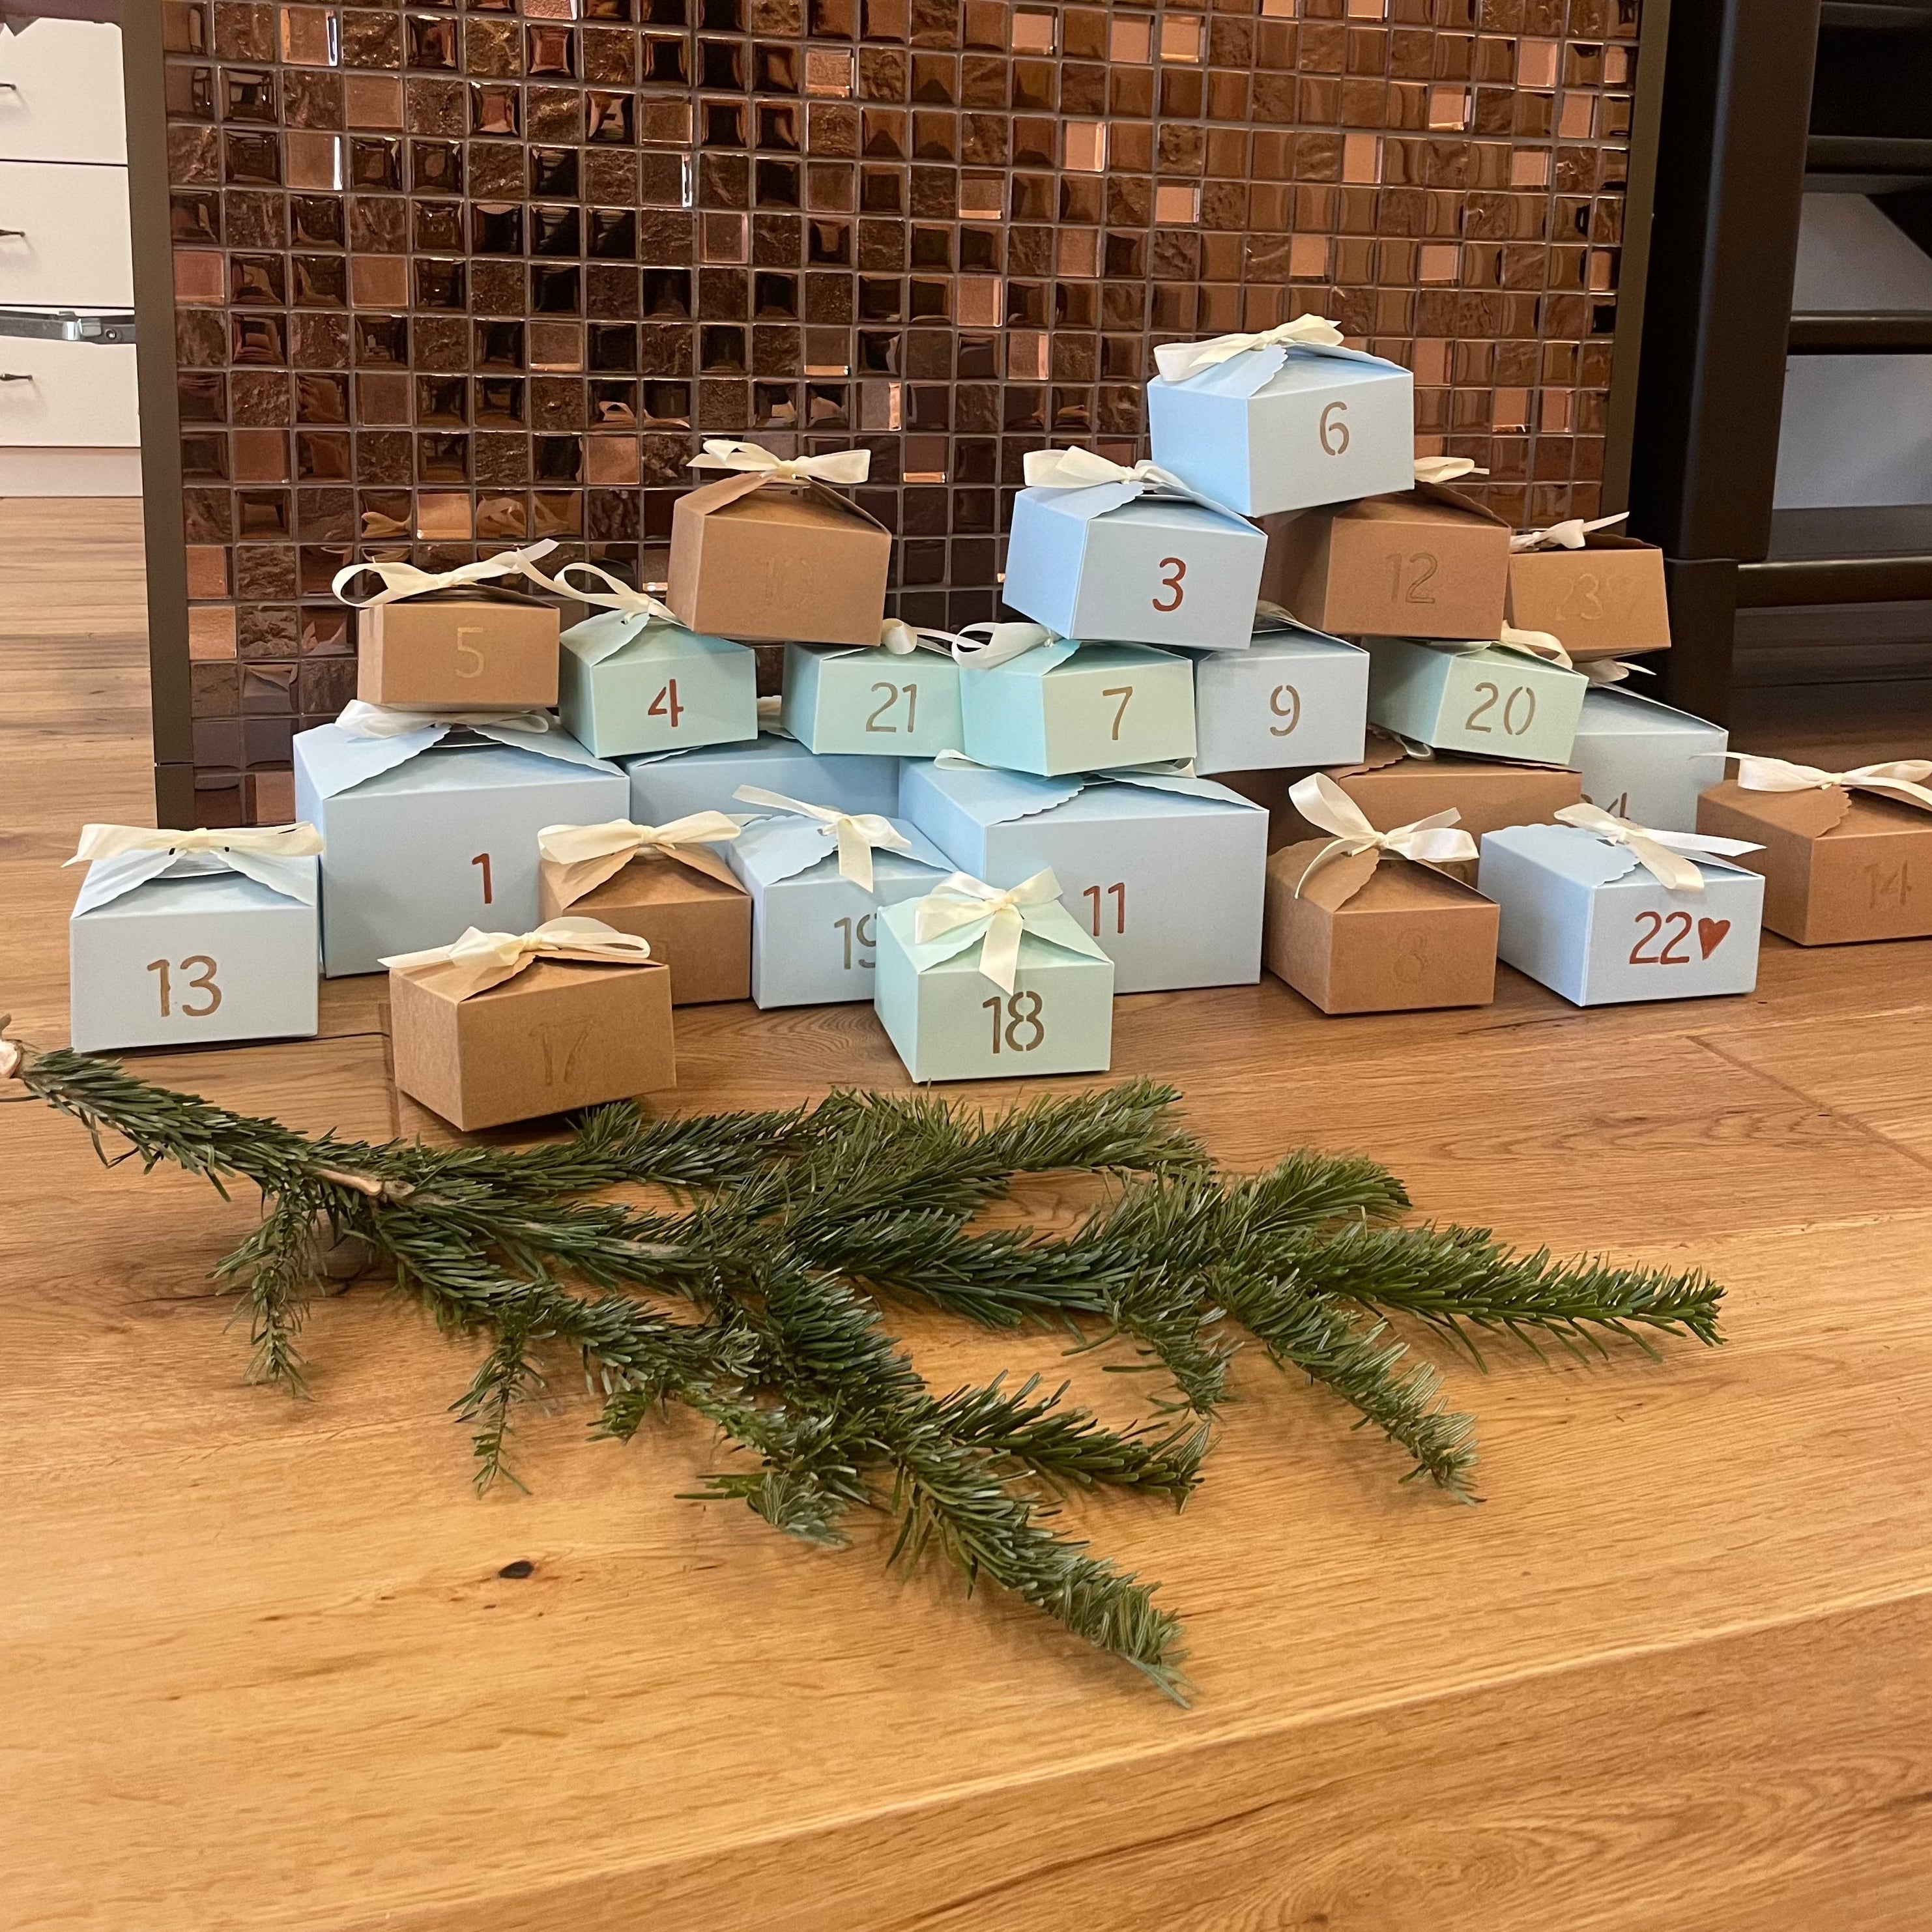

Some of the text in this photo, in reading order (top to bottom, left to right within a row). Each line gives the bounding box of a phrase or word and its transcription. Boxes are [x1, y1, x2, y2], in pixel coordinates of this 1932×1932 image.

[1319, 401, 1349, 456] 6
[1152, 556, 1187, 612] 3
[1386, 551, 1439, 605] 12
[455, 626, 485, 678] 5
[648, 678, 684, 728] 4
[865, 682, 917, 733] 21
[1102, 685, 1133, 741] 7
[1269, 685, 1301, 737] 9
[1465, 682, 1536, 736] 20
[471, 853, 493, 904] 1
[1083, 882, 1125, 937] 11
[1628, 911, 1693, 966] 22
[147, 955, 222, 1018] 13
[982, 990, 1045, 1054] 18
